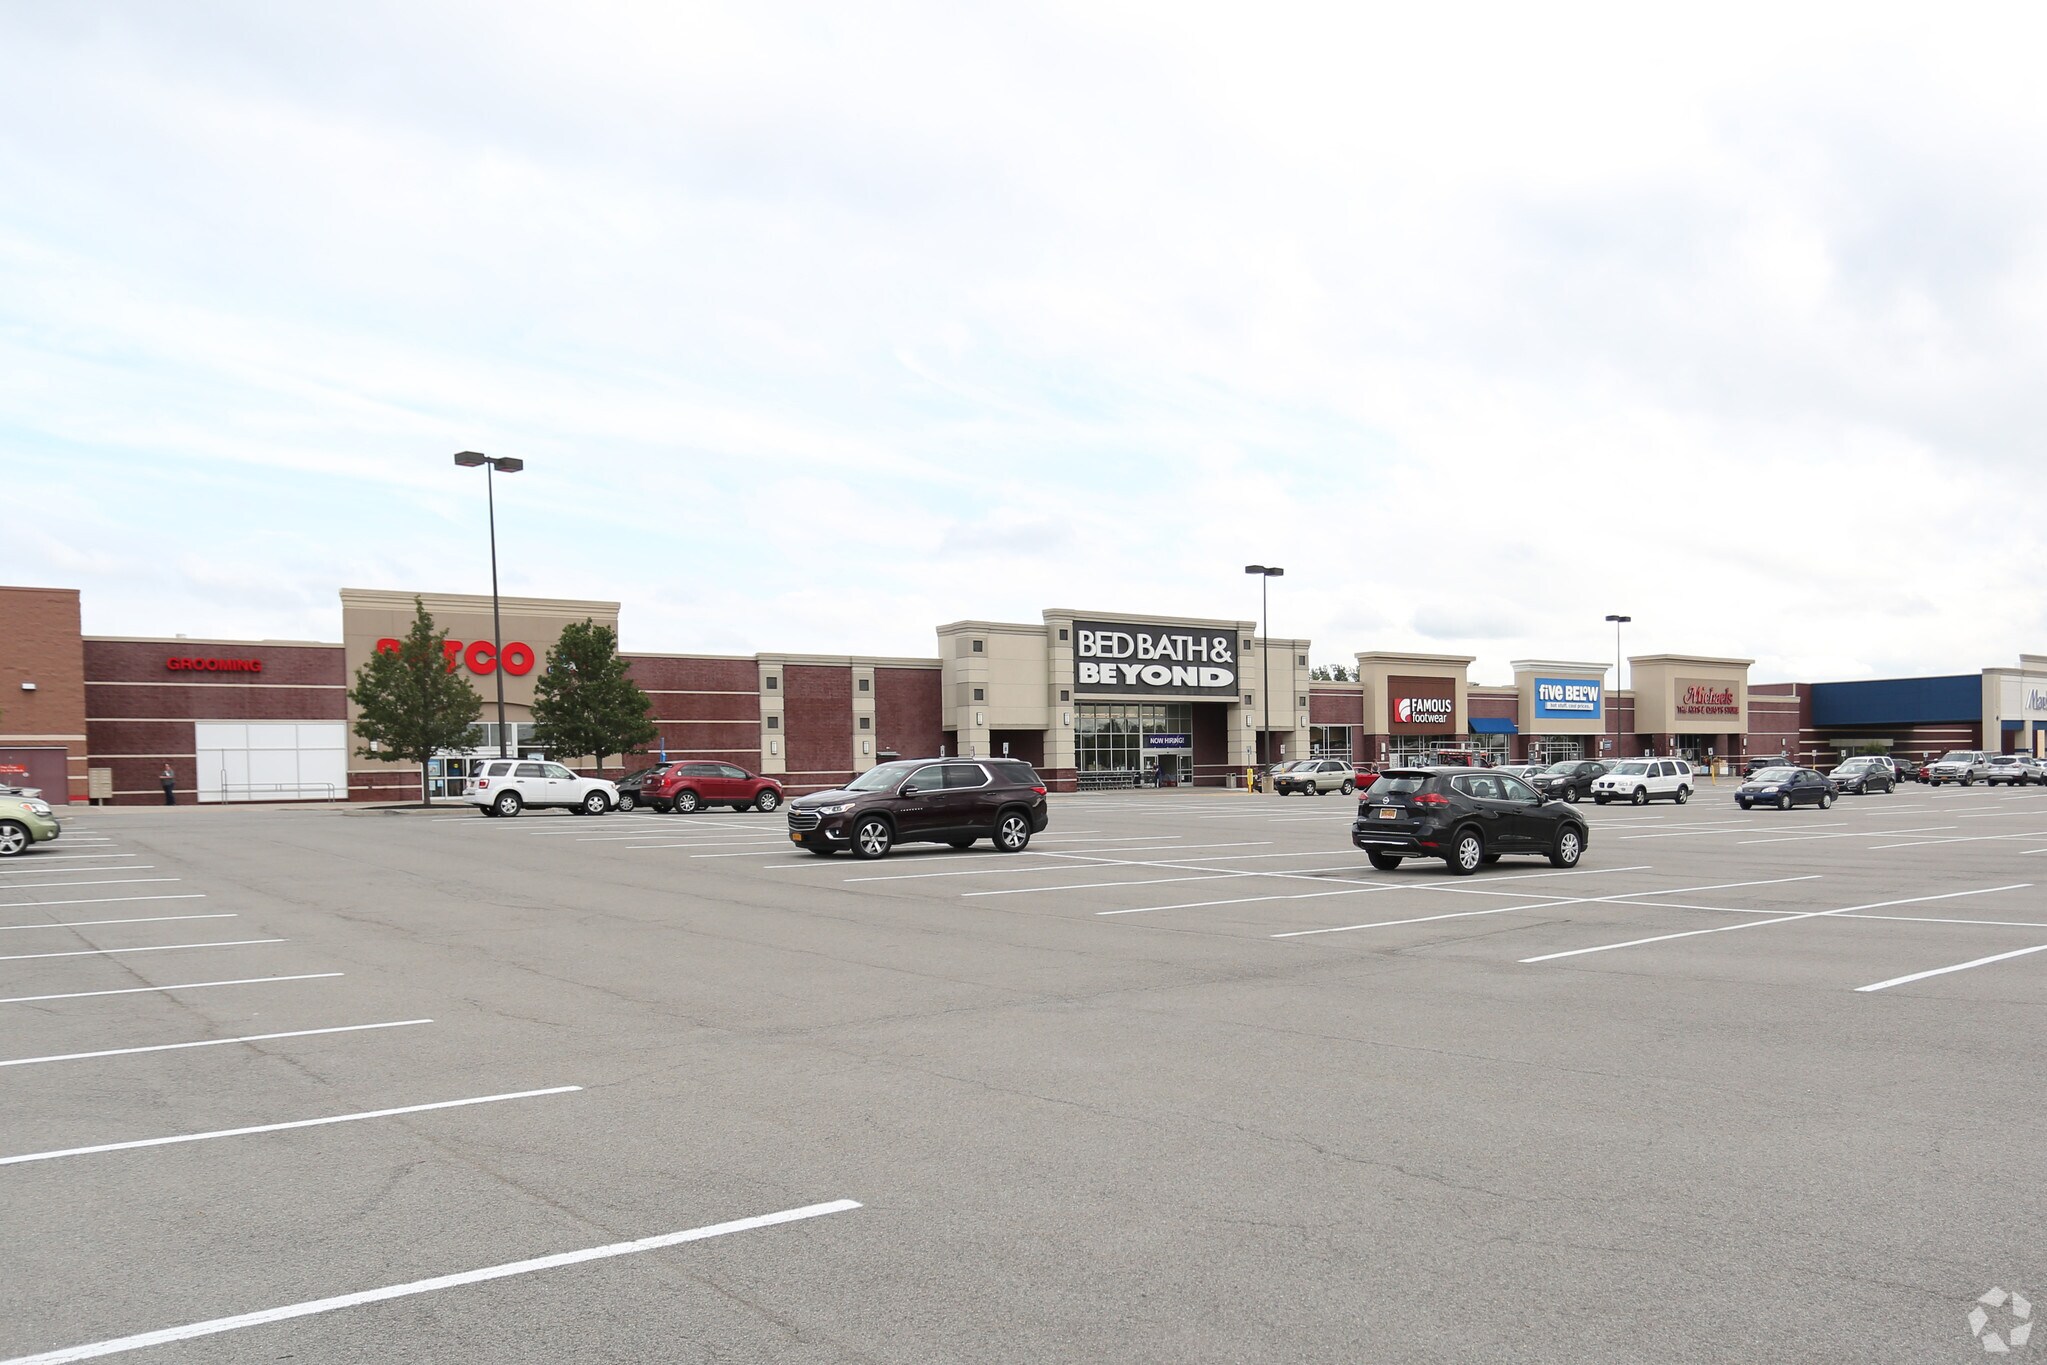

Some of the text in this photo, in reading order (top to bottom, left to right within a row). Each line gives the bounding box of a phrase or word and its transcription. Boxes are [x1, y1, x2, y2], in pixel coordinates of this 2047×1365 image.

[1078, 630, 1234, 663] BED BATH &
[166, 657, 263, 672] GROOMING
[376, 638, 535, 676] TCO
[1078, 662, 1235, 687] BEYOND
[1539, 684, 1564, 700] five
[1683, 686, 1733, 704] Michaels
[1411, 698, 1452, 712] FAMOUS
[1412, 711, 1447, 723] footwear
[1164, 736, 1185, 744] HIRING!
